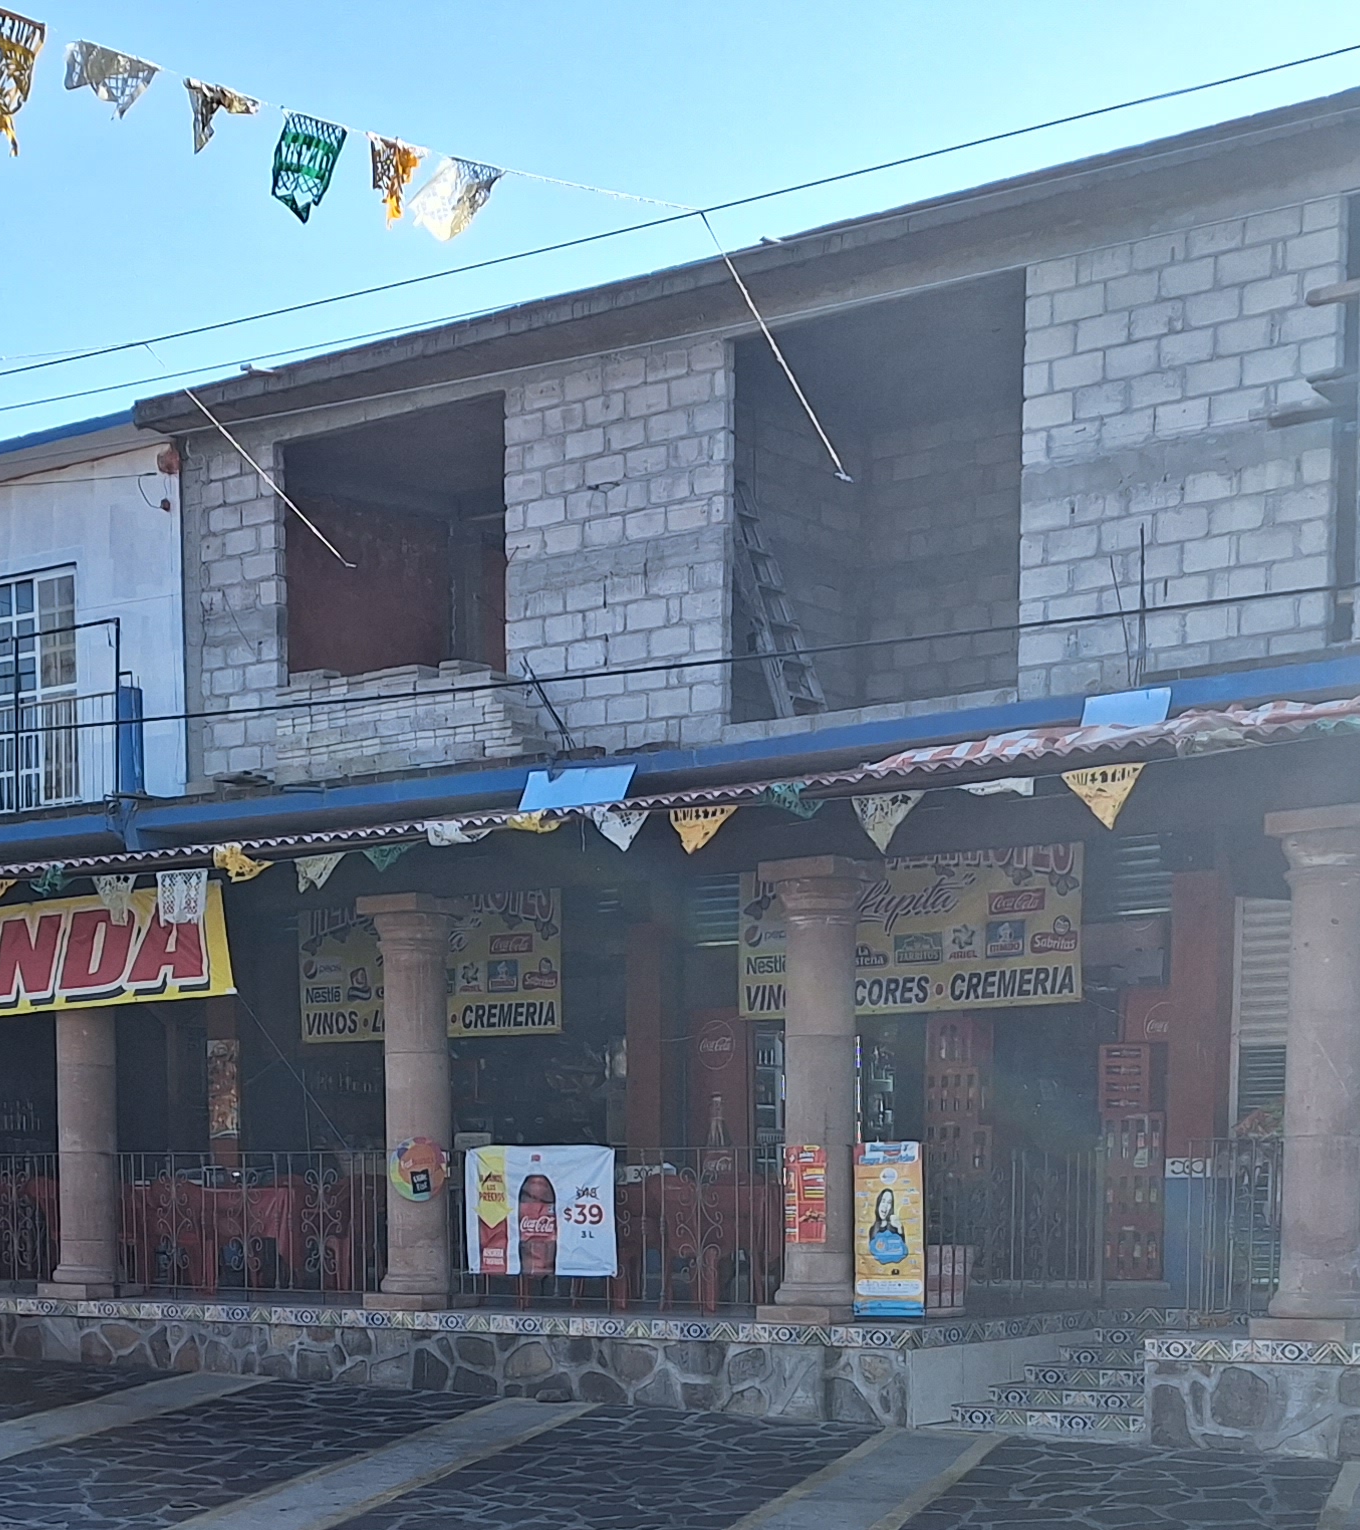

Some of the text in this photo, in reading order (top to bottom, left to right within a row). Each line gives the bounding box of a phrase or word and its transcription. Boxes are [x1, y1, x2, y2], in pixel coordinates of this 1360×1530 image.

[1033, 934, 1076, 950] Sabritas
[745, 965, 1075, 1012] VIN CORES CREMERIA
[306, 1010, 359, 1036] VINOS
[461, 1001, 556, 1029] CREMERIA
[563, 1203, 604, 1226] $39
